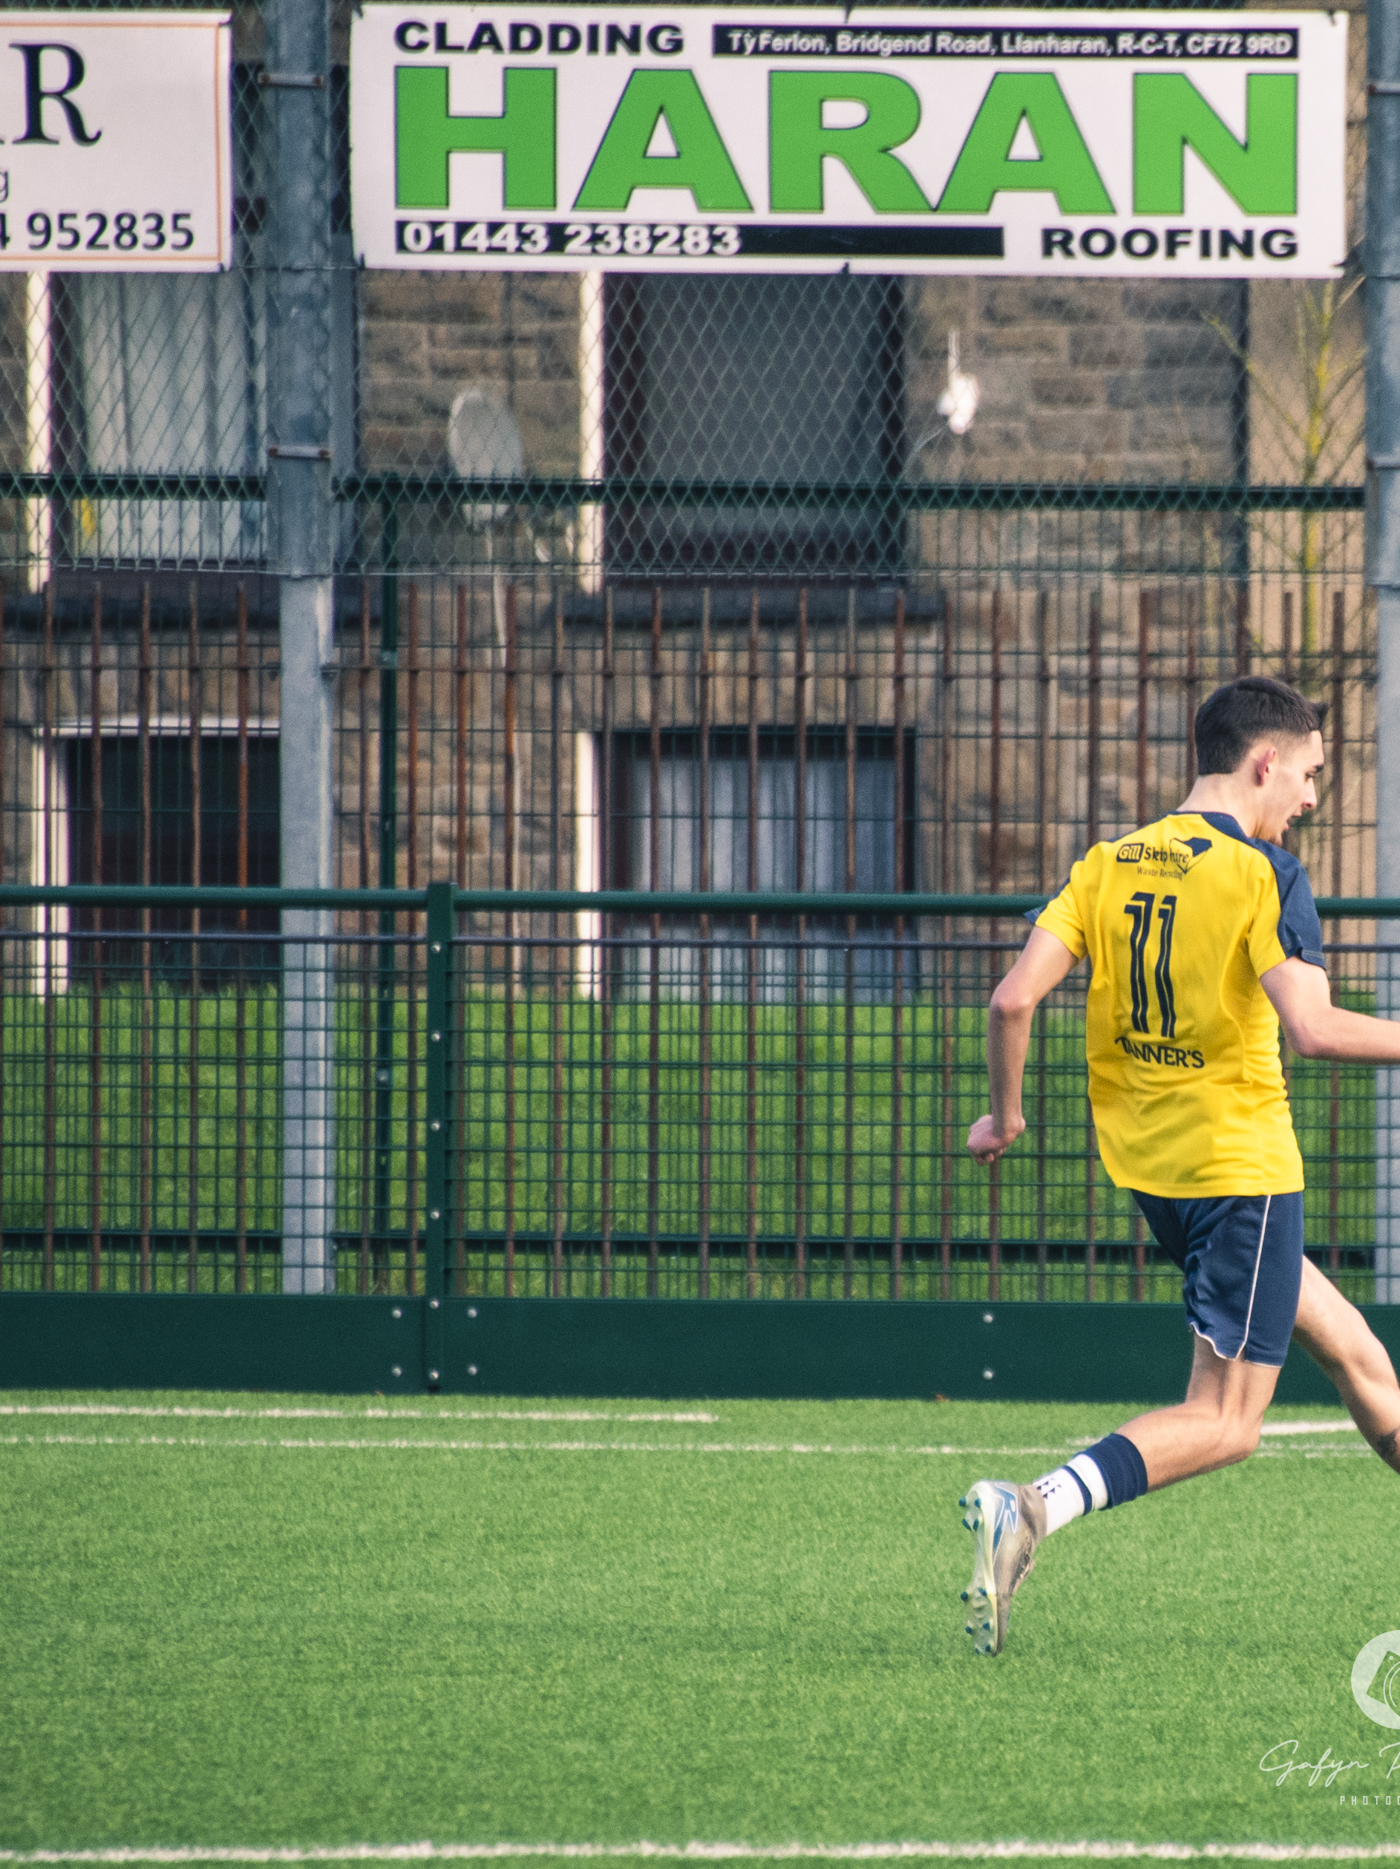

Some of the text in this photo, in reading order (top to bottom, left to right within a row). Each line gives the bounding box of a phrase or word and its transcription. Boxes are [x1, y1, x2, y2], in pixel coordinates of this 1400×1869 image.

[394, 22, 684, 54] CLADDING
[836, 32, 932, 57] Bridgend
[936, 33, 998, 56] Road,
[1001, 34, 1113, 58] Llanharan,
[1117, 35, 1182, 58] R-C-T,
[1186, 36, 1242, 54] CF72
[1246, 36, 1292, 55] 9RD
[0, 42, 103, 147] R
[394, 66, 1299, 216] HARAN
[27, 211, 194, 251] 952835
[403, 222, 742, 255] 01443 238283
[1042, 229, 1299, 259] ROOFING
[1124, 891, 1177, 1038] 11
